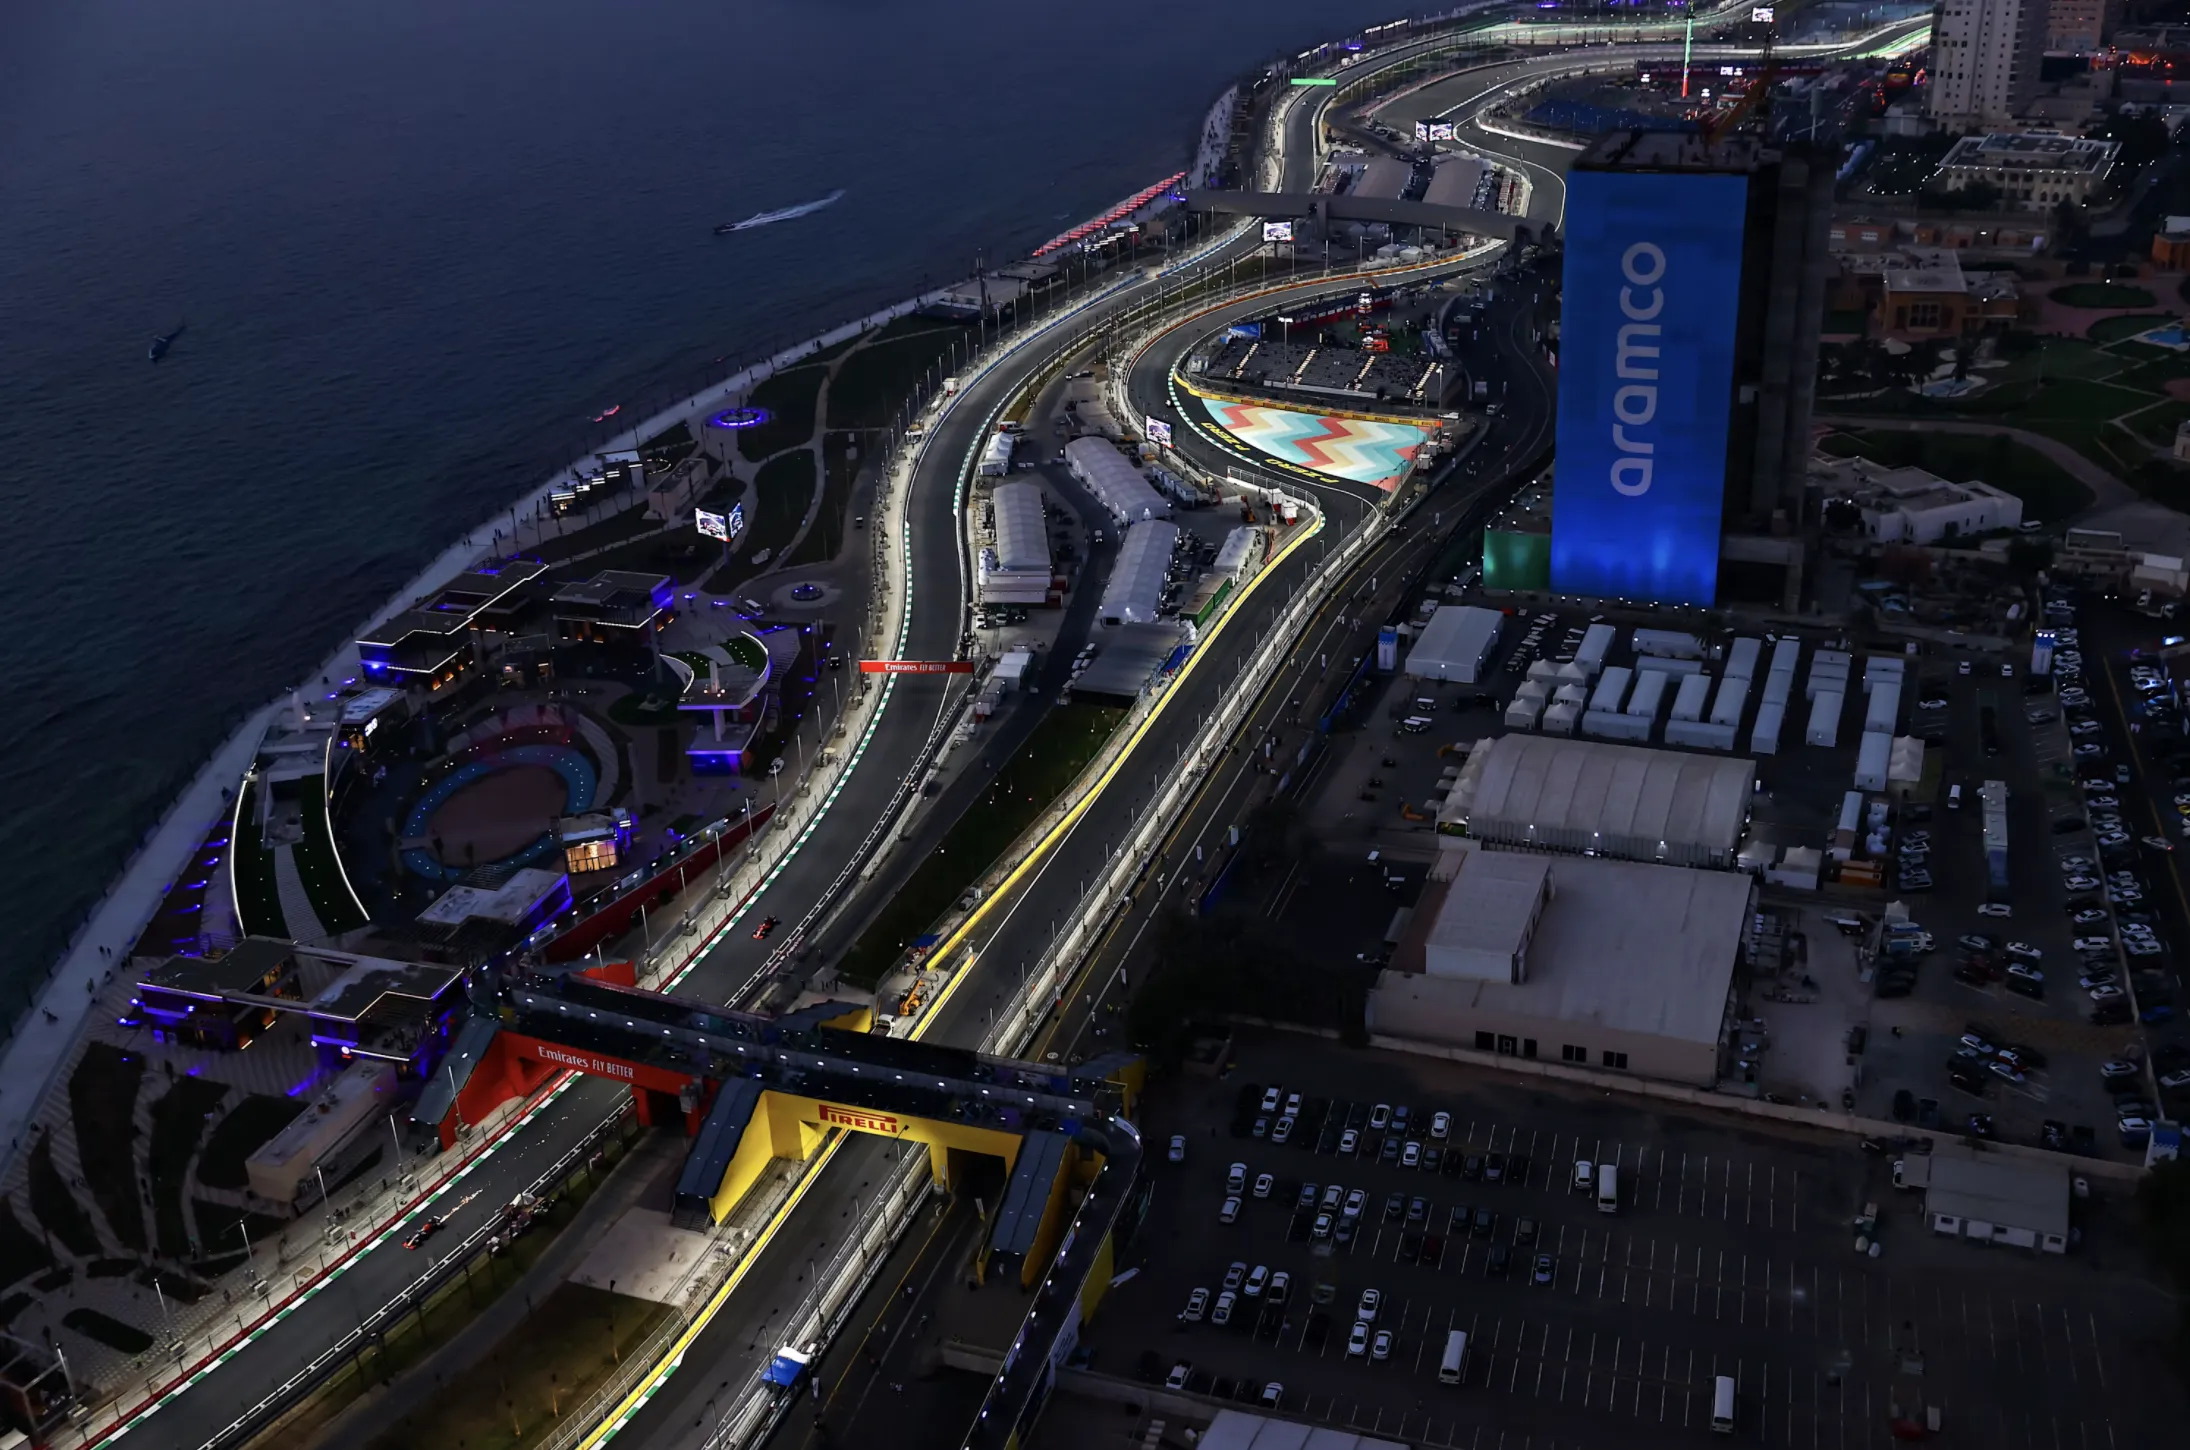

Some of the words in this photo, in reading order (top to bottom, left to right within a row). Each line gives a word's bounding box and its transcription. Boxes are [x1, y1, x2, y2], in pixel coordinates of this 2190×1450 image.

[1610, 241, 1667, 497] aramco
[1201, 422, 1240, 445] ZERO
[885, 663, 917, 672] Emirates
[538, 1045, 589, 1068] Emirates
[592, 1059, 605, 1073] FLY
[606, 1063, 634, 1079] BETTER
[818, 1104, 897, 1134] PIRELLI
